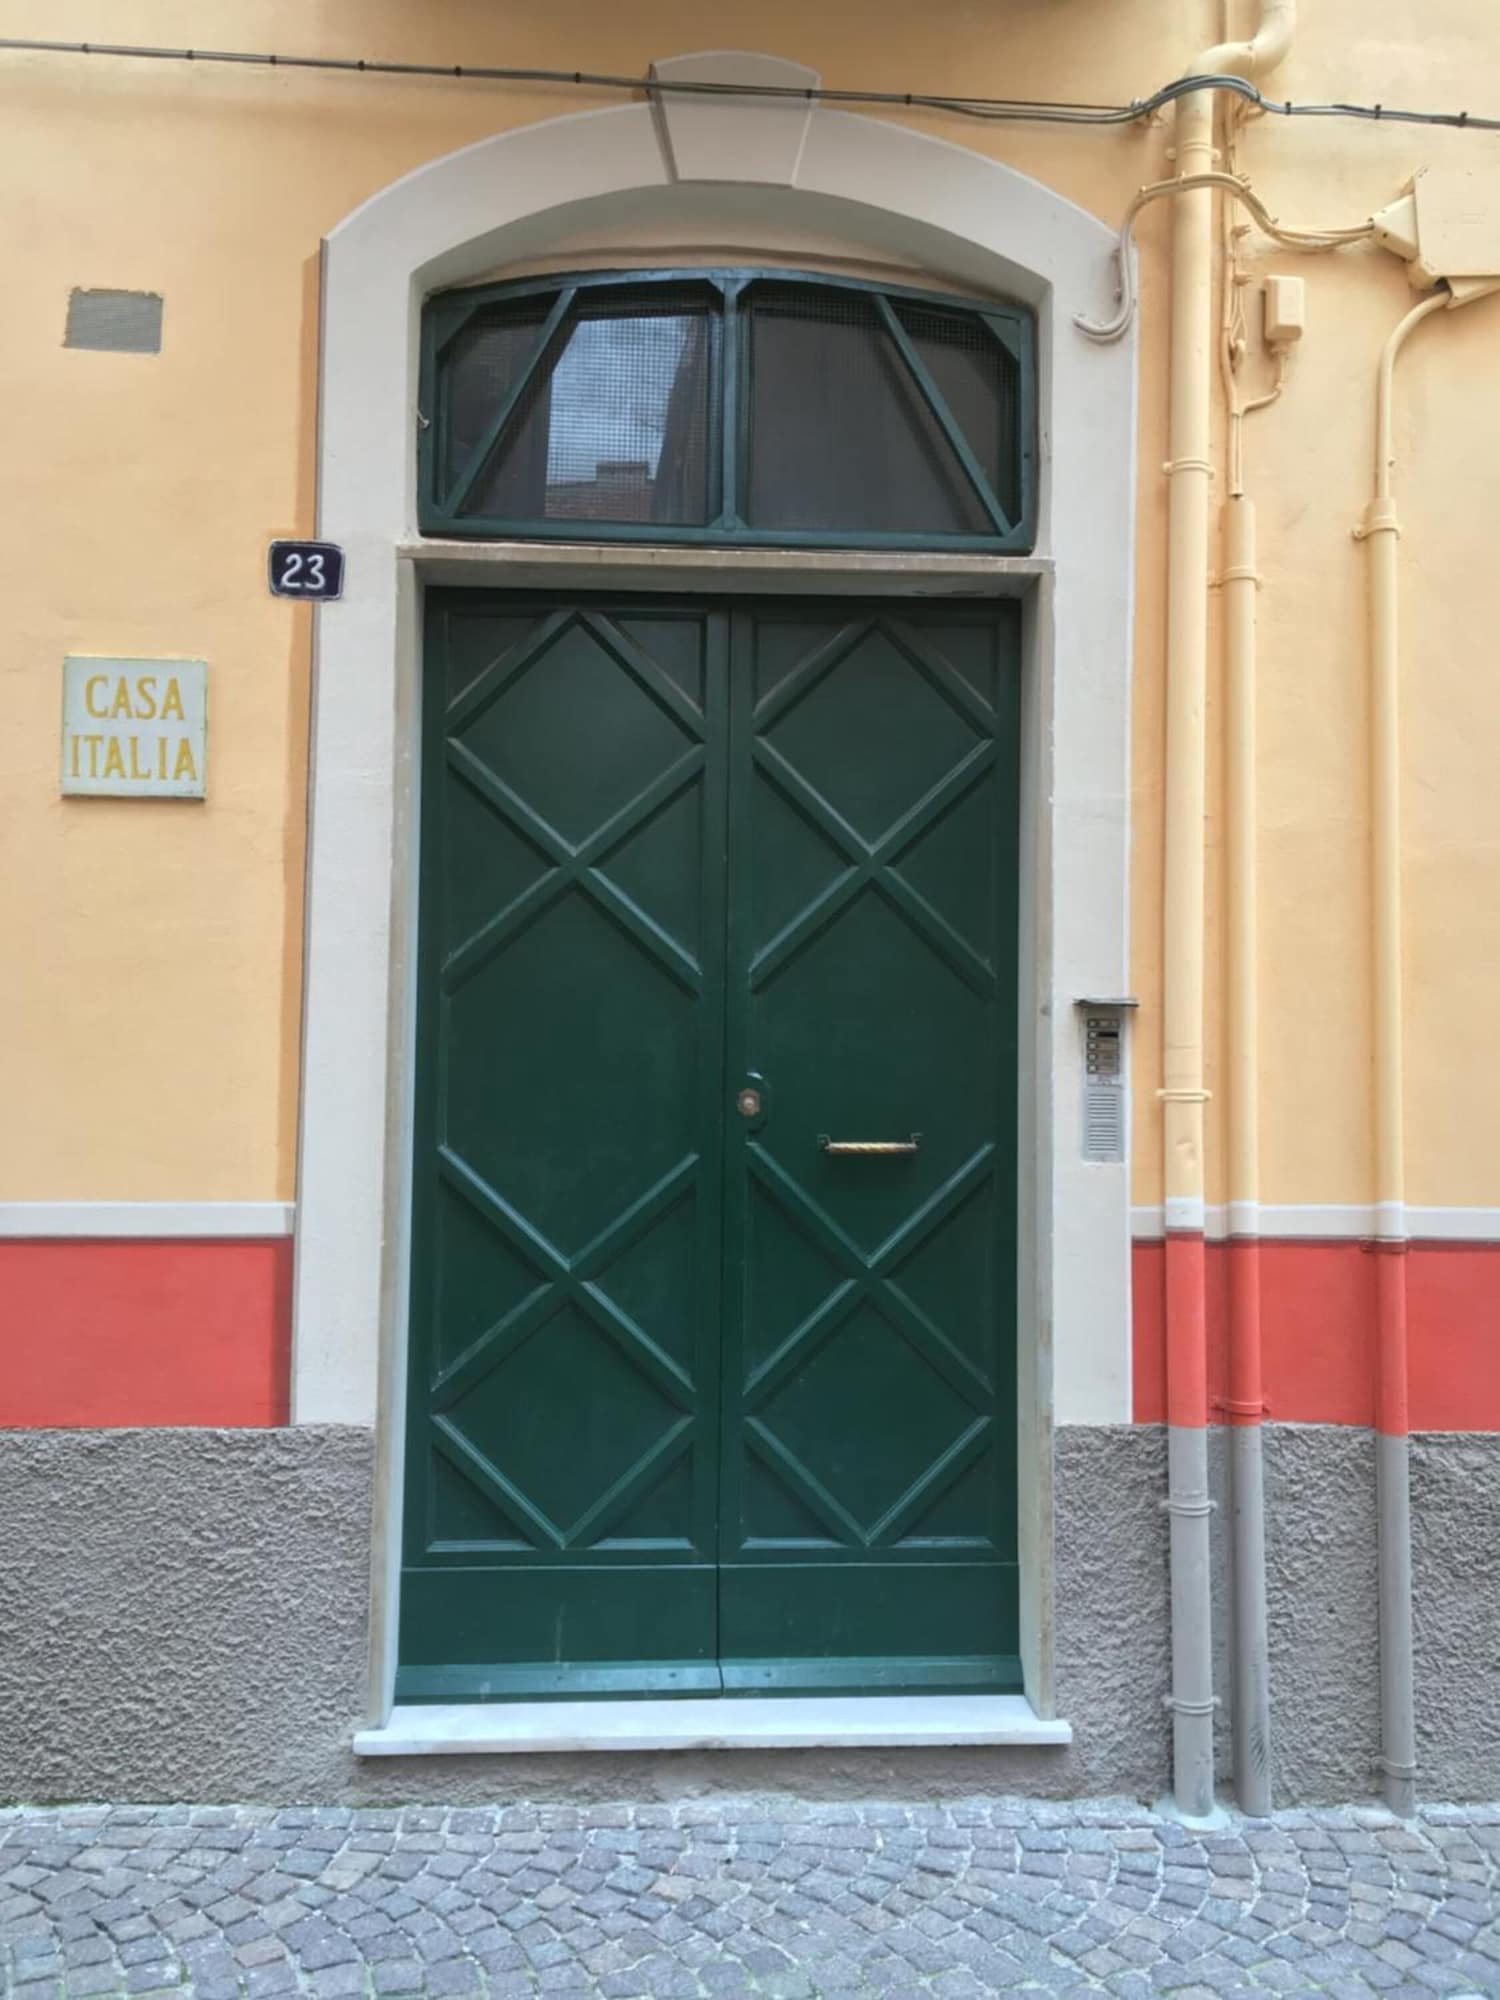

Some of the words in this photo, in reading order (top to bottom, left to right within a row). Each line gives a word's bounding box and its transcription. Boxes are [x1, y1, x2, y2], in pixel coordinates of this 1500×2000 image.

[281, 553, 326, 590] 23
[85, 675, 185, 720] CASA
[71, 735, 198, 781] ITALIA
